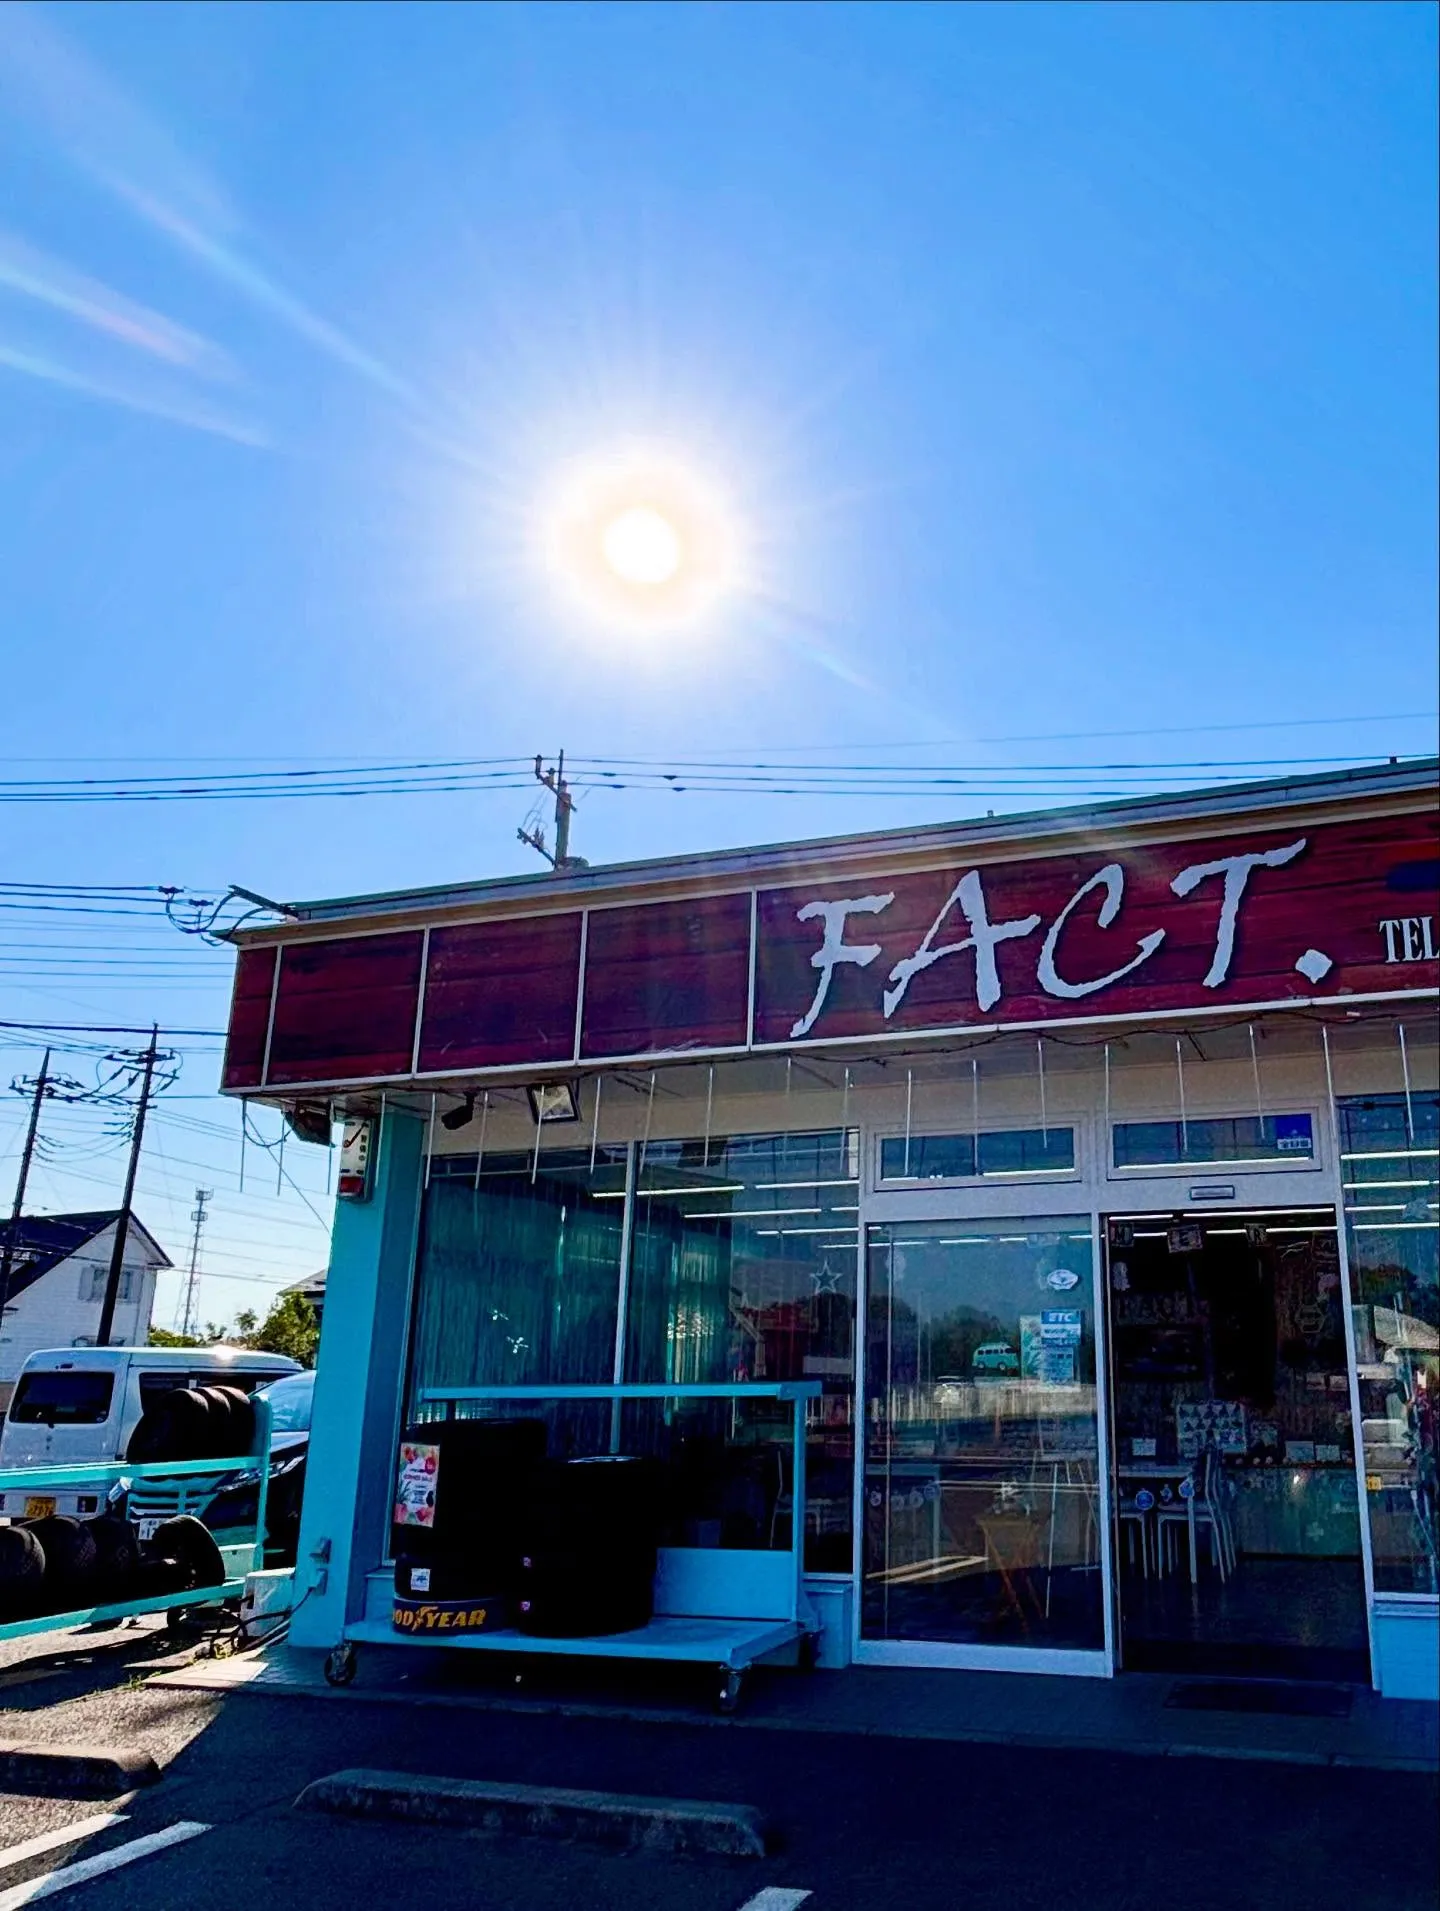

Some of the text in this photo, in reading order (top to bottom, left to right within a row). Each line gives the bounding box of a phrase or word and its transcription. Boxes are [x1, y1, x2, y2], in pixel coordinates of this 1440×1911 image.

[790, 838, 1334, 1038] FACT.
[1378, 916, 1440, 964] TEL
[1048, 1312, 1073, 1322] ETC
